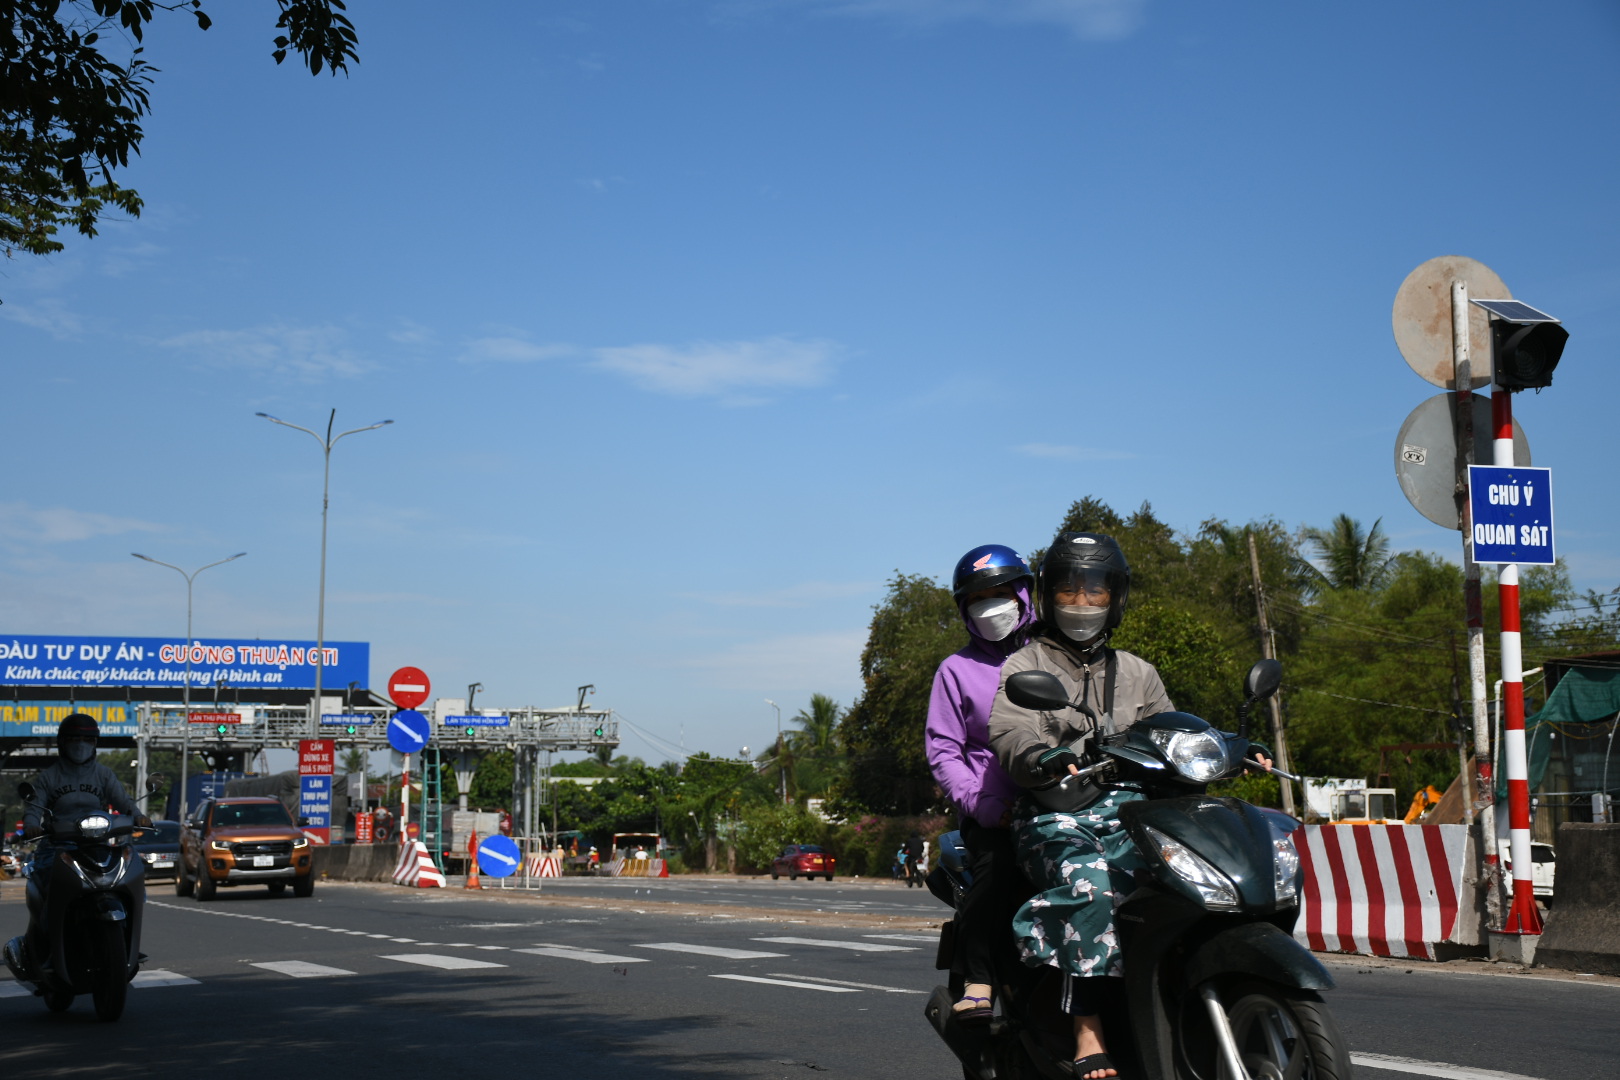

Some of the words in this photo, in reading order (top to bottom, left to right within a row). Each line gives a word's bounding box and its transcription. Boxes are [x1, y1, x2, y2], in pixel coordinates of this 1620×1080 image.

[1488, 479, 1520, 506] CHÚ
[1523, 480, 1533, 507] Ý
[1474, 523, 1516, 545] QUAN
[1520, 519, 1548, 546] SÁT
[44, 644, 75, 661] TƯ
[80, 644, 111, 664] DỰ
[115, 642, 143, 661] ÁN
[159, 641, 235, 664] CƯỜNG
[238, 644, 305, 670] THUẬN
[307, 647, 338, 667] CTI
[5, 665, 42, 681] Kính
[44, 667, 81, 681] chúc
[82, 667, 110, 683] quý
[110, 667, 155, 682] khách
[158, 669, 212, 685] thượng
[229, 669, 261, 683] bình
[263, 672, 283, 683] an
[228, 714, 239, 722] ETC
[321, 753, 330, 762] XE
[300, 763, 312, 773] QUÁ
[317, 763, 332, 773] PHÚT
[309, 779, 323, 789] LÀN
[303, 791, 315, 800] THU
[316, 790, 328, 800] PHÍ
[308, 816, 324, 826] ETC)
